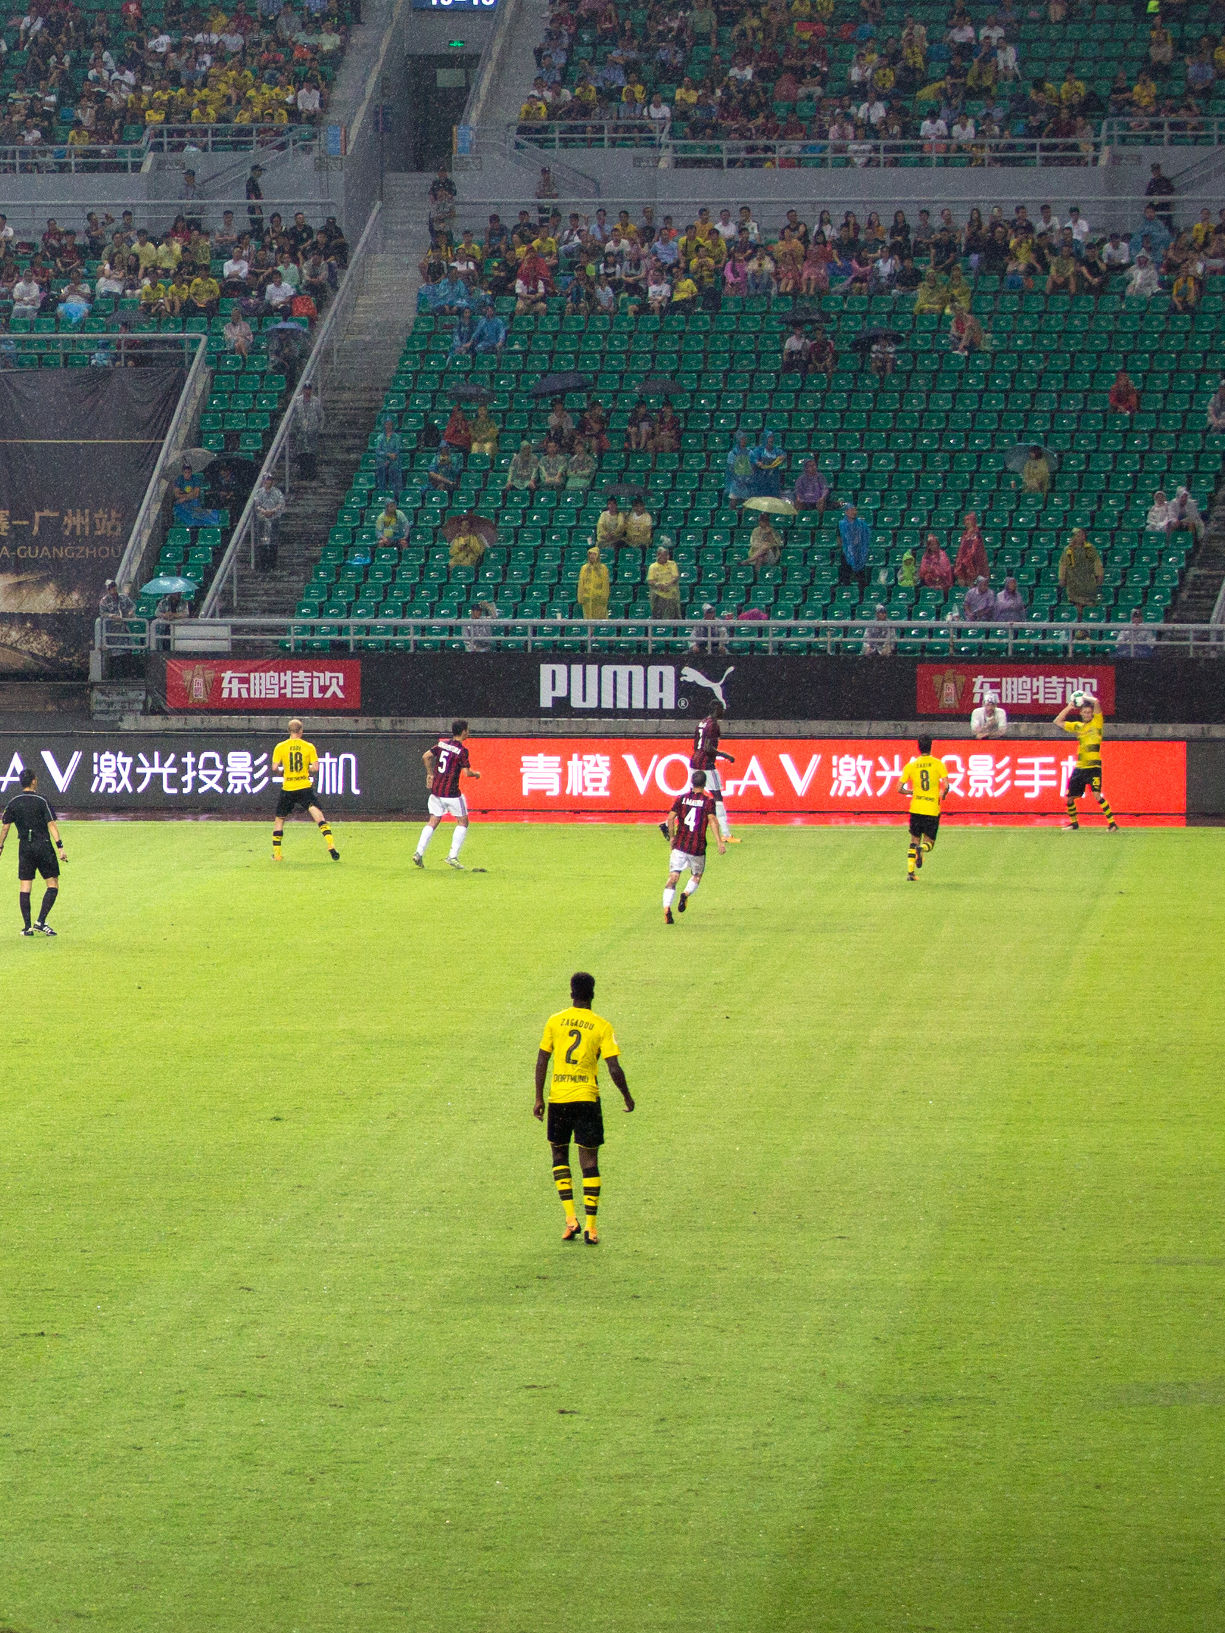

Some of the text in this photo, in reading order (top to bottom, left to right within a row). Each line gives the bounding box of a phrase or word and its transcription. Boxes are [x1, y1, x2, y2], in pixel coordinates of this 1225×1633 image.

[221, 670, 345, 699] 东鹏特饮
[539, 663, 675, 709] PUMA
[40, 750, 83, 792] V
[90, 750, 361, 795] 激光投影机
[289, 751, 303, 772] 18
[437, 750, 449, 774] 5
[519, 753, 611, 797] 青橙
[779, 753, 822, 797] V
[920, 769, 930, 791] 8
[683, 807, 697, 832] 4
[560, 1018, 595, 1031] ZAGADOU
[565, 1029, 582, 1065] 2
